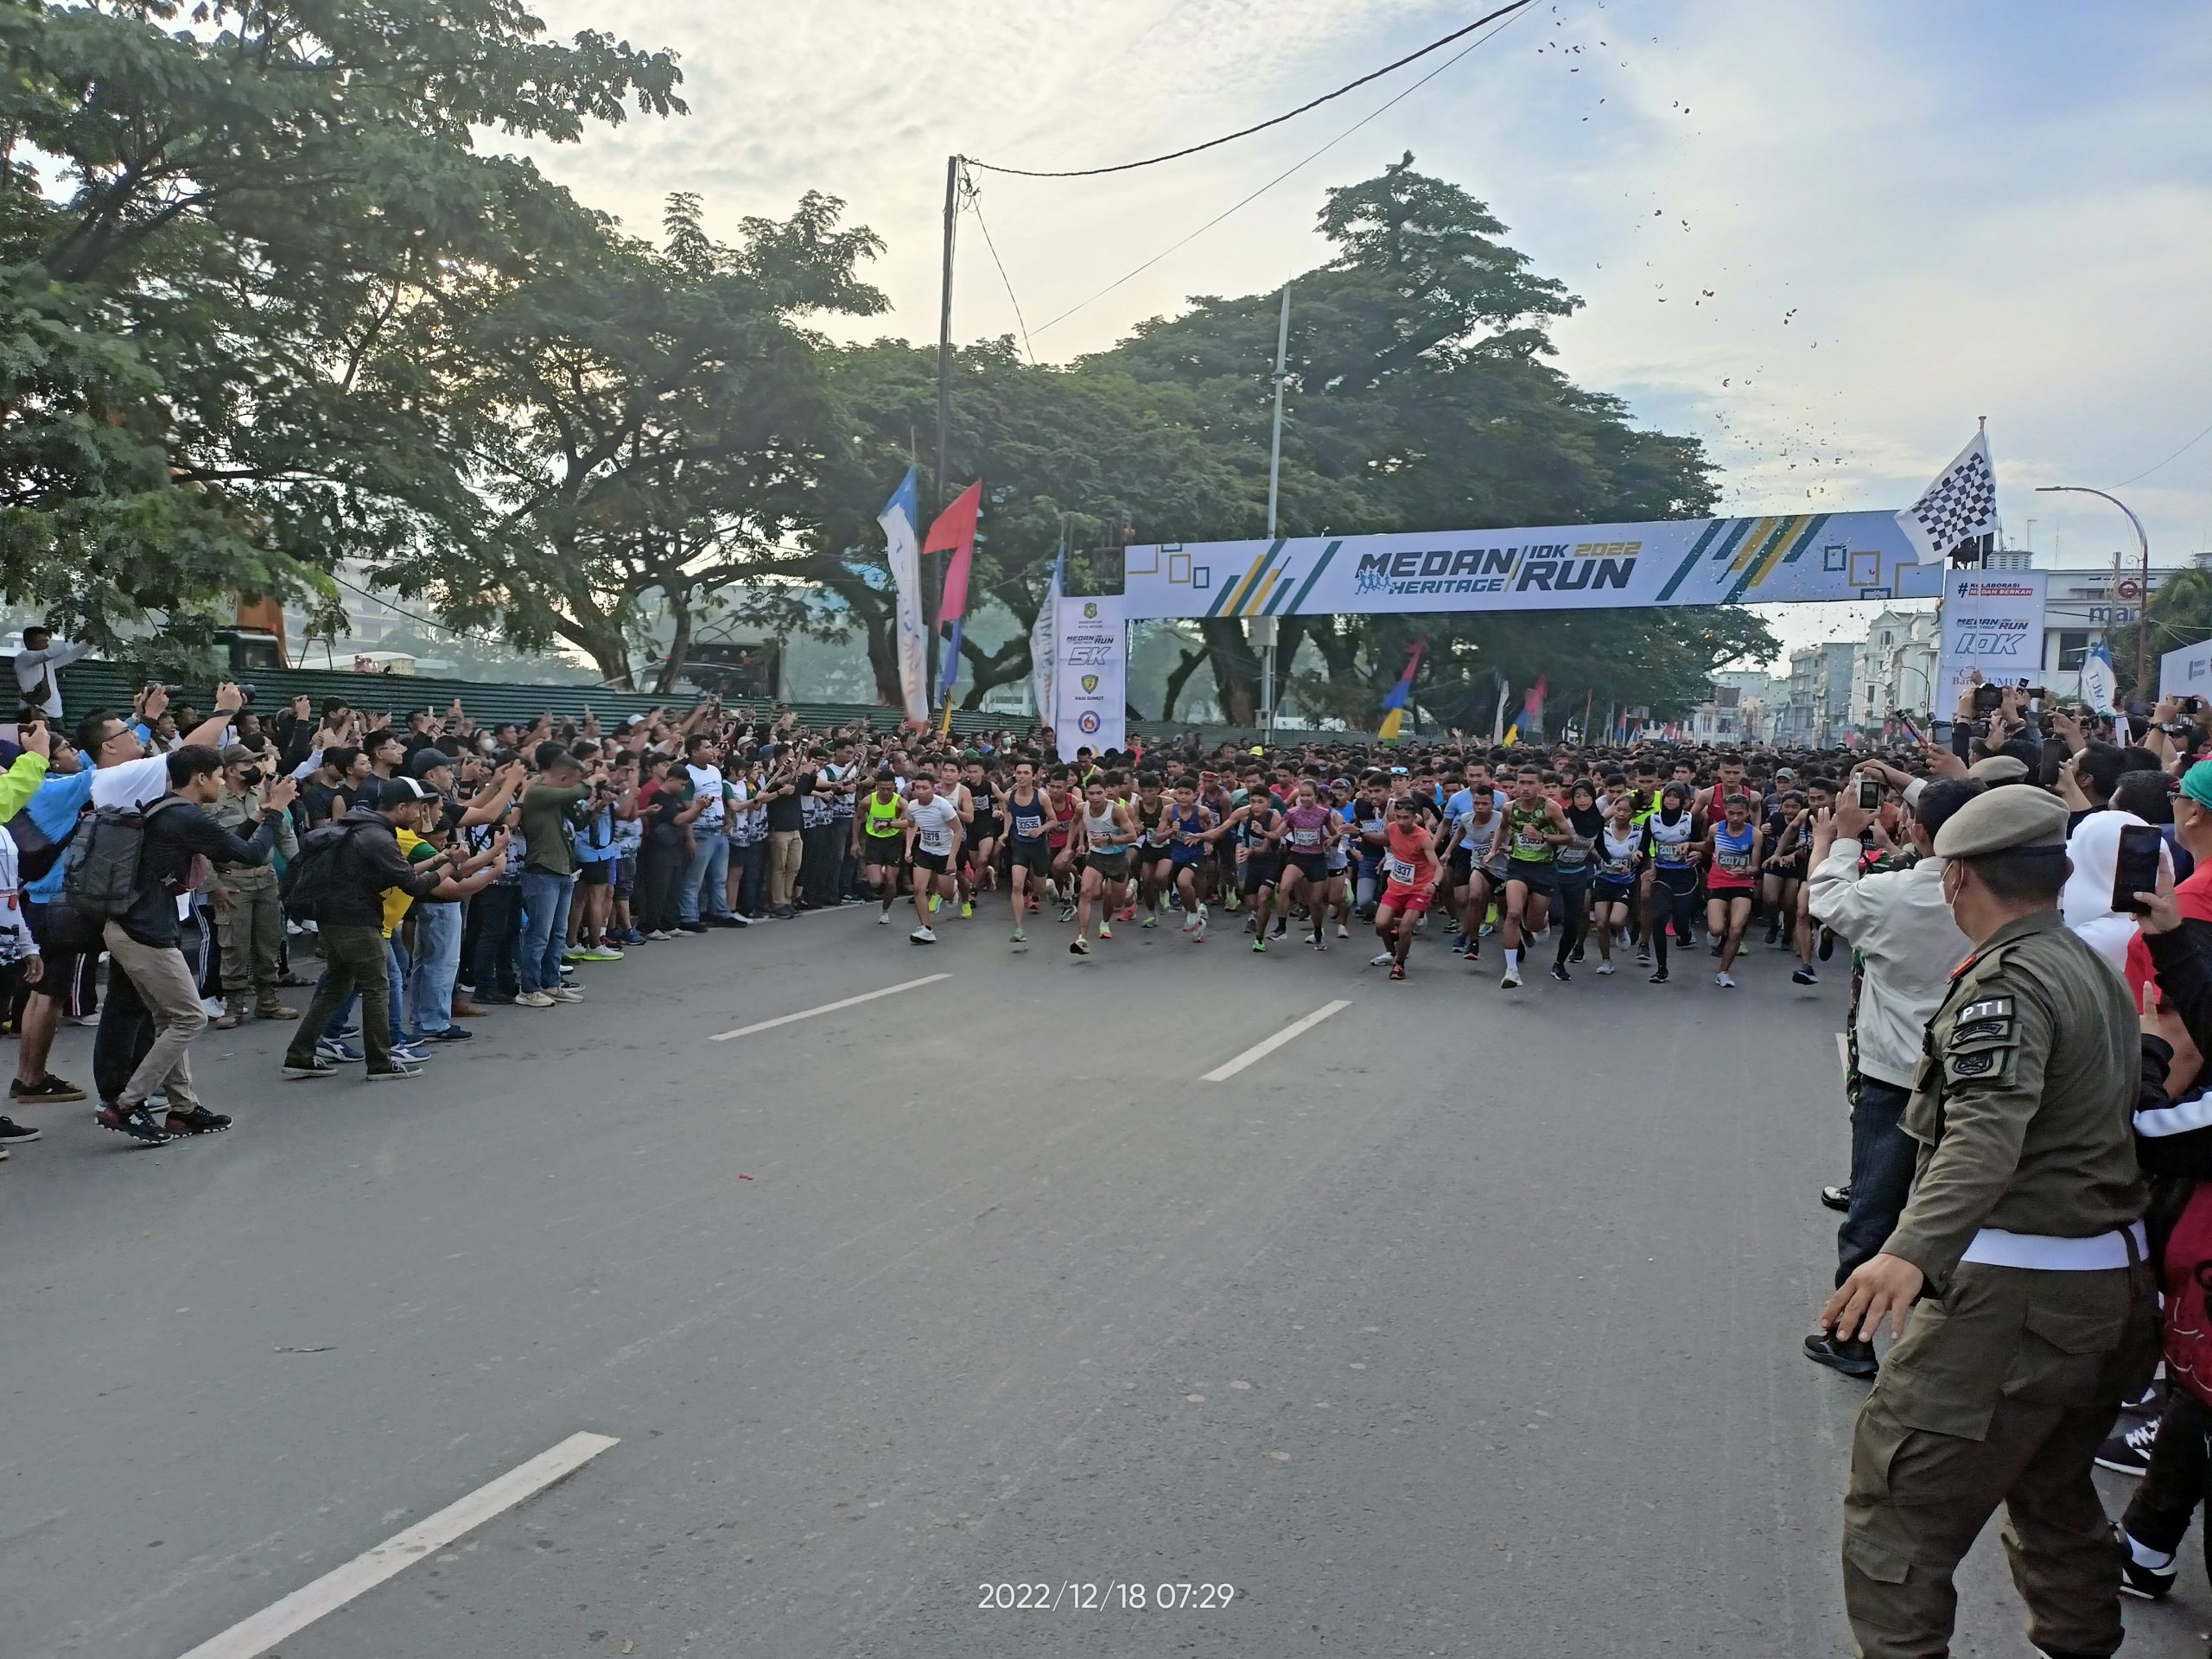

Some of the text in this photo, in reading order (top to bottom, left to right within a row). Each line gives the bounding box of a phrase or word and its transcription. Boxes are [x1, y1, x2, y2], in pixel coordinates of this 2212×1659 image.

[1529, 542, 1643, 559] 10K 2022
[1355, 548, 1517, 578] MEDAN
[1516, 557, 1637, 592] RUN
[1389, 578, 1505, 594] HERITAGE
[1955, 632, 2027, 655] 10K
[1068, 646, 1111, 665] 5K
[1962, 1001, 2003, 1021] PTI
